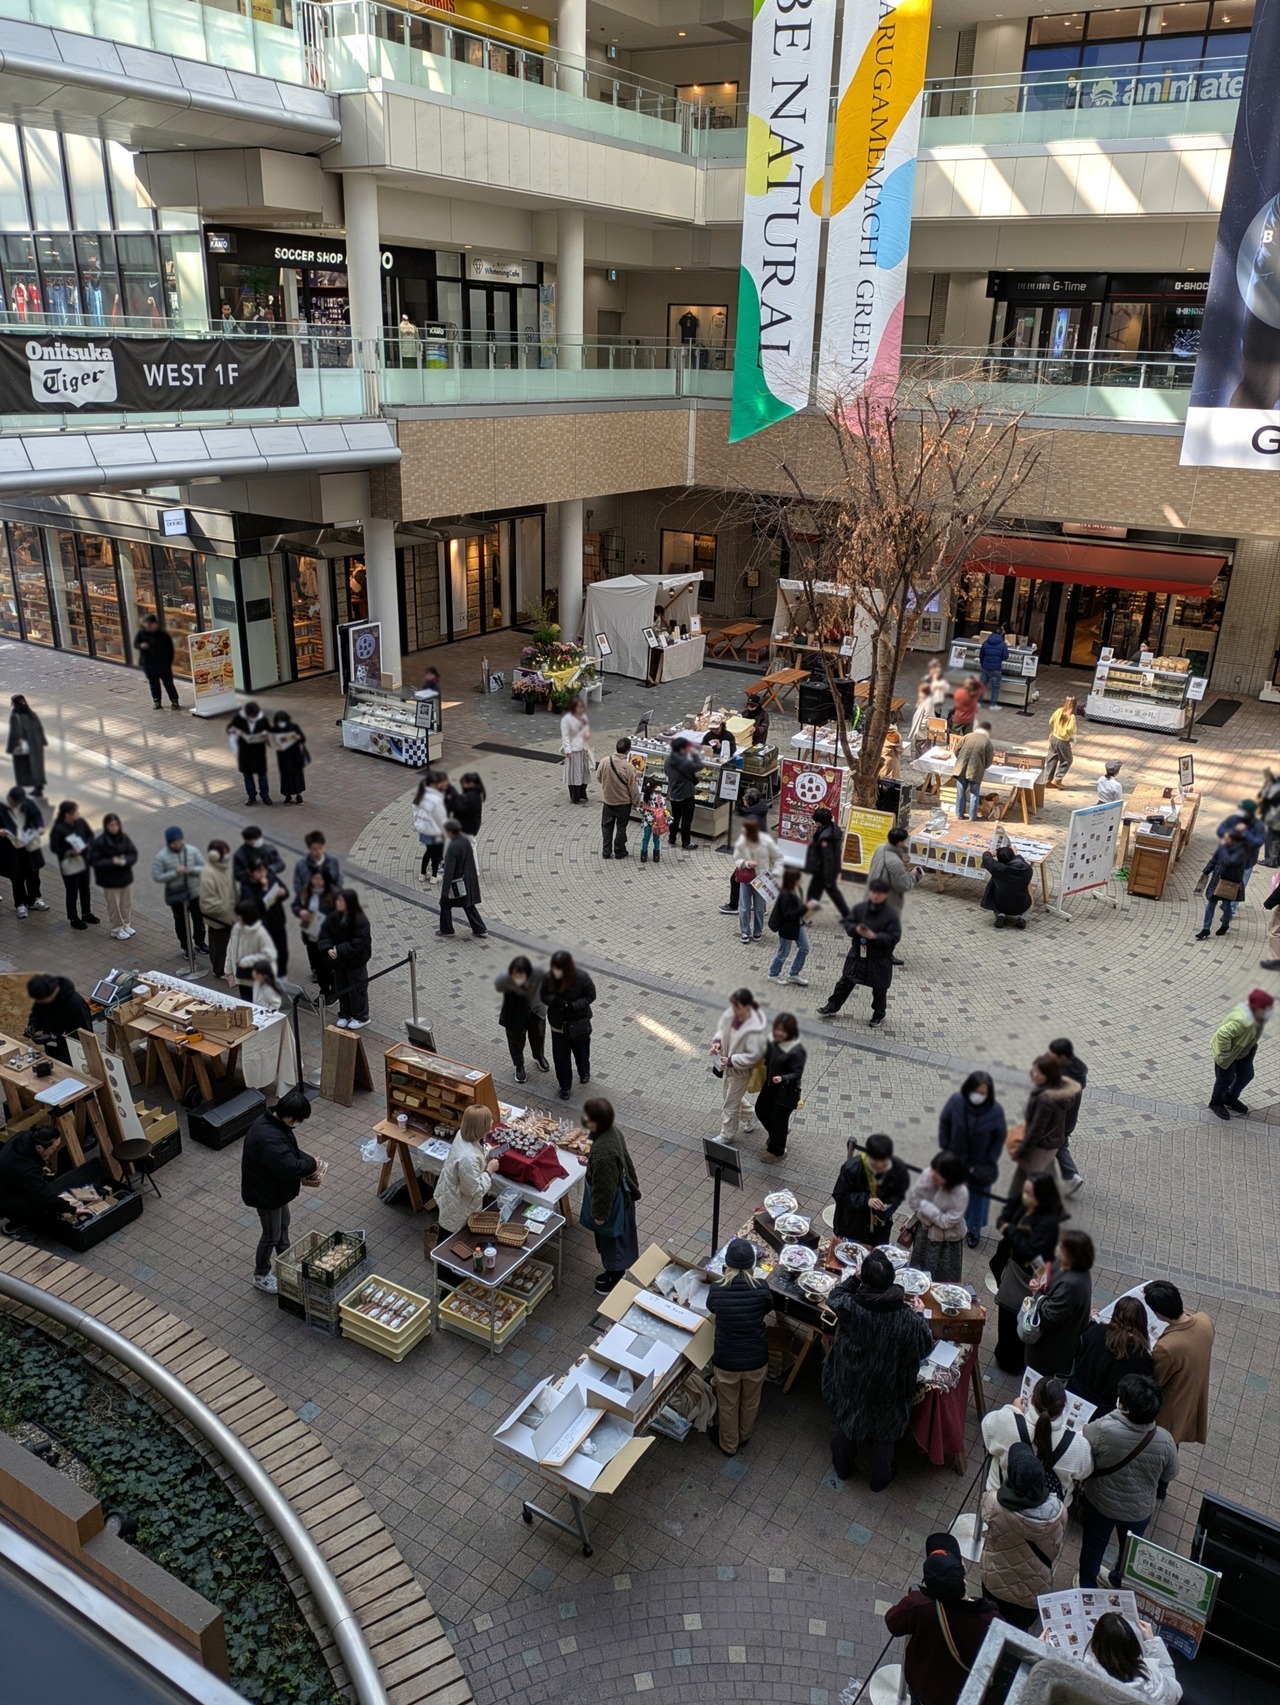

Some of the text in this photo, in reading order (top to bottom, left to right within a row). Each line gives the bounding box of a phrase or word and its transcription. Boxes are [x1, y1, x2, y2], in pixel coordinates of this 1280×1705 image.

[1122, 70, 1244, 104] animate
[757, 74, 810, 370] NATURAL
[274, 247, 315, 262] SOCCER
[316, 251, 343, 264] SHOP
[1053, 281, 1087, 291] G-Time
[1174, 281, 1209, 291] G-SHOC
[851, 279, 875, 377] GREEN
[25, 340, 114, 361] Onitsuka
[43, 367, 105, 395] Tiger
[143, 363, 239, 387] WEST 1F
[1161, 1556, 1183, 1569] お願い
